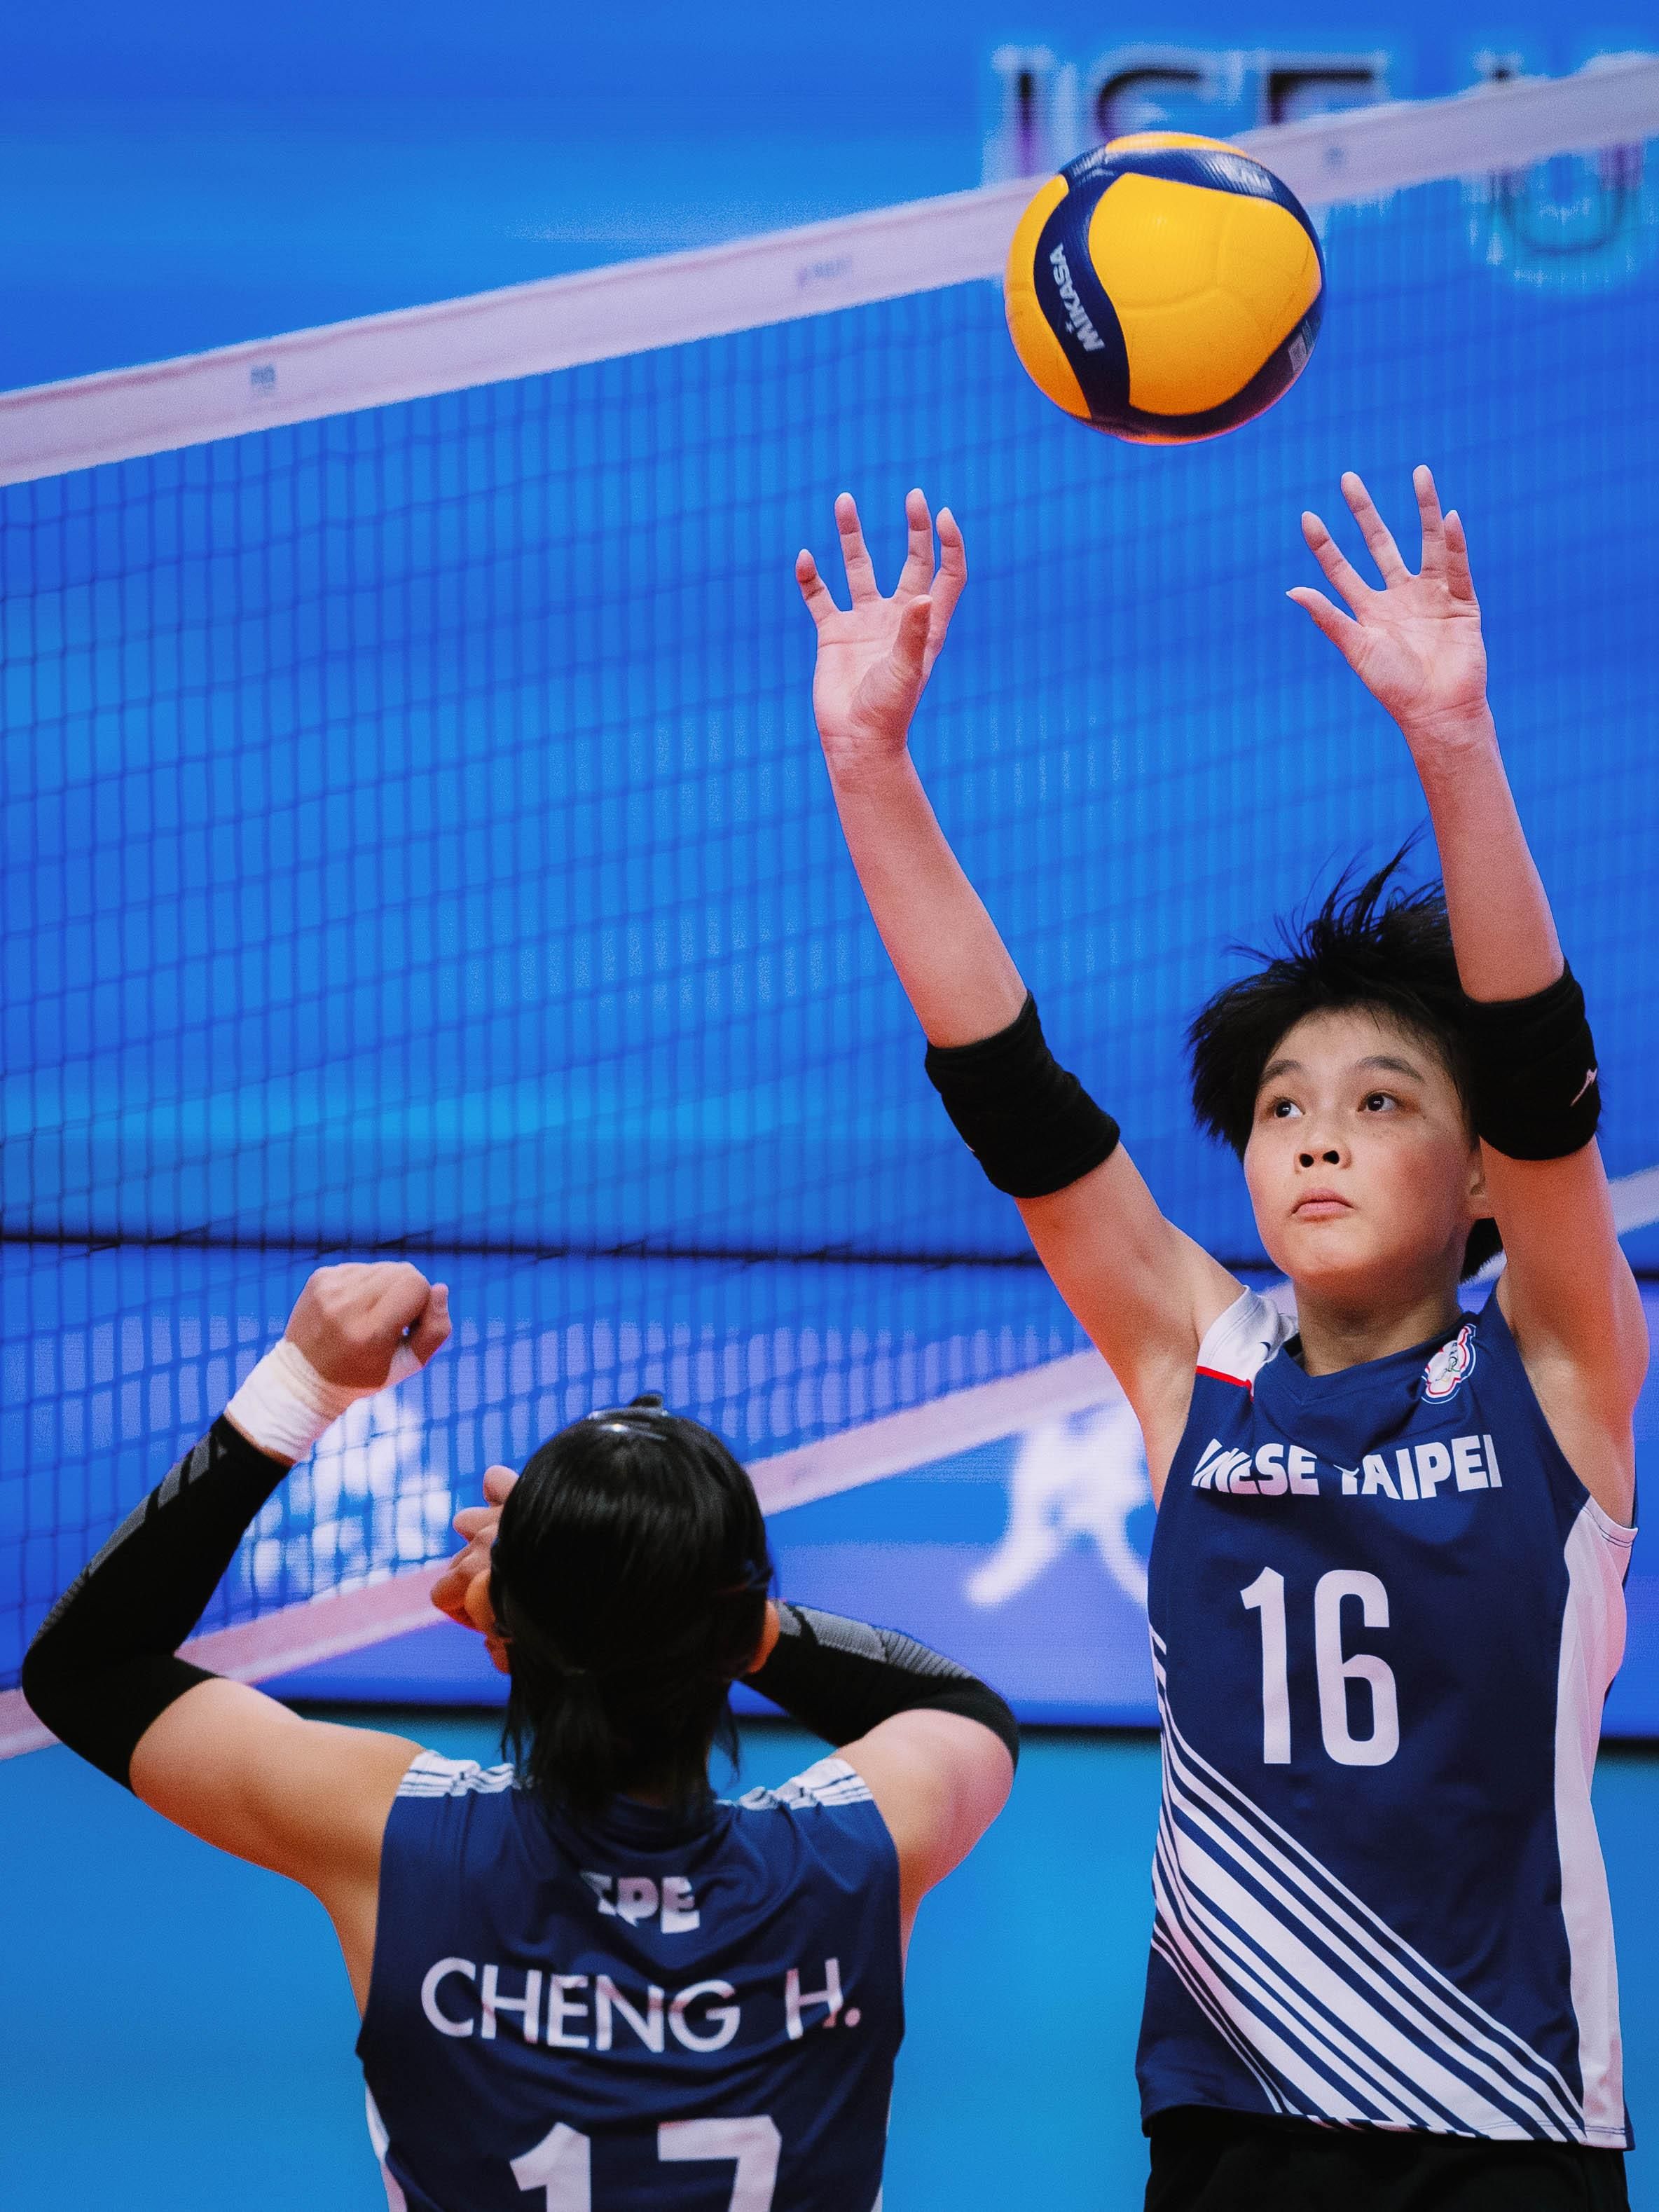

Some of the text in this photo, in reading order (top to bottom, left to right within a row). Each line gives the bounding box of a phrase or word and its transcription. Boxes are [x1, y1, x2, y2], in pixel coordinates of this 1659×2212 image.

[1239, 1566, 1400, 1766] 16
[421, 1957, 862, 2053] CHENG H.
